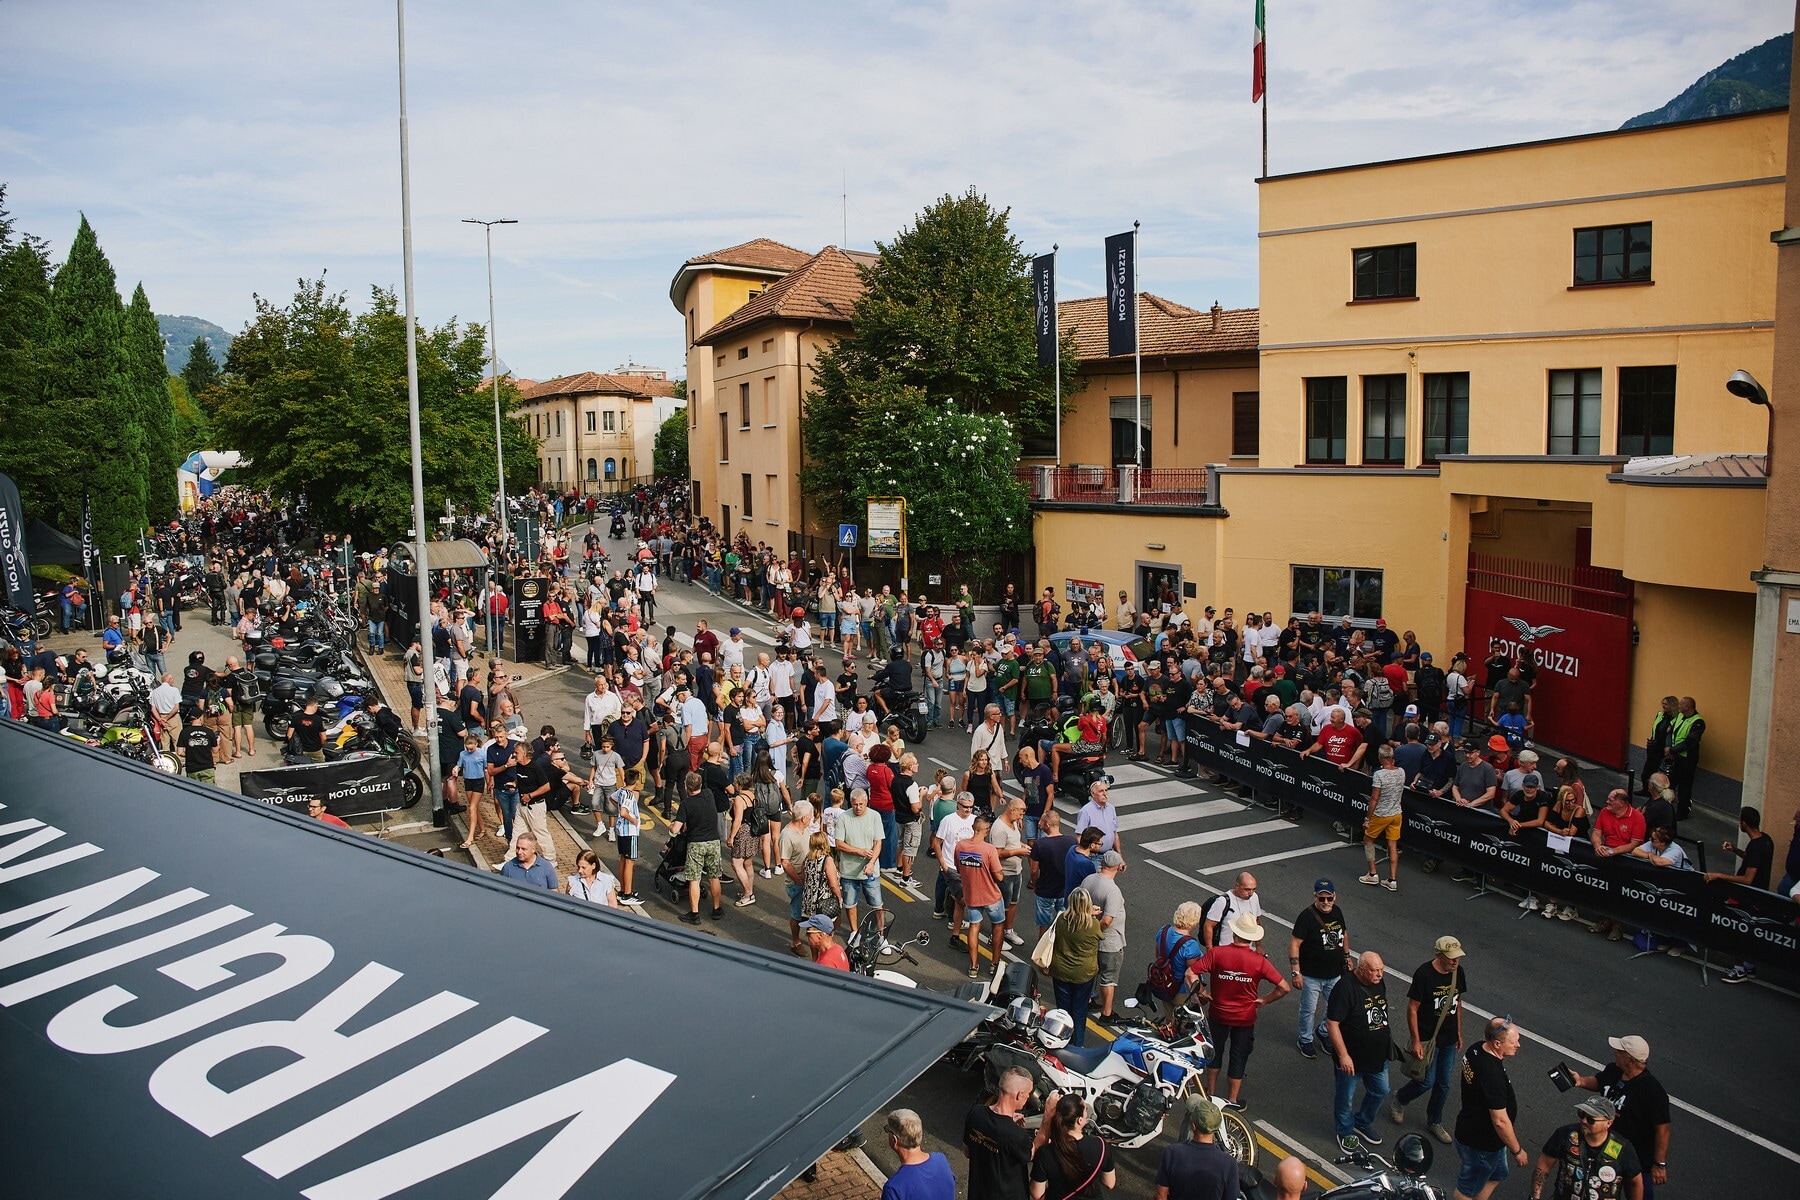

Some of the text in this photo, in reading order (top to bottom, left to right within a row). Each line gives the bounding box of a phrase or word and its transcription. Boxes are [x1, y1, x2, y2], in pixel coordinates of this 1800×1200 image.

[1118, 249, 1126, 285] GUZZI
[1533, 647, 1579, 678] GUZZI
[1199, 741, 1215, 753] GUZZI
[1219, 749, 1252, 769] MOTO GUZZI
[1256, 764, 1296, 785] MOTO GUZZI
[257, 794, 316, 805] OTO GUZZ
[329, 788, 357, 800] MOTO
[360, 782, 391, 794] GUZZI
[1301, 780, 1345, 803] MOTO GUZZI
[1408, 818, 1461, 845] MOTO GUZZI
[1470, 840, 1531, 867] MOTO GUZZI
[1541, 862, 1609, 891] MOTO GUZZI
[1621, 886, 1697, 918] MOTO GUZZI
[1711, 913, 1796, 949] MOTO GUZZI
[0, 867, 678, 1200] VIRGIN
